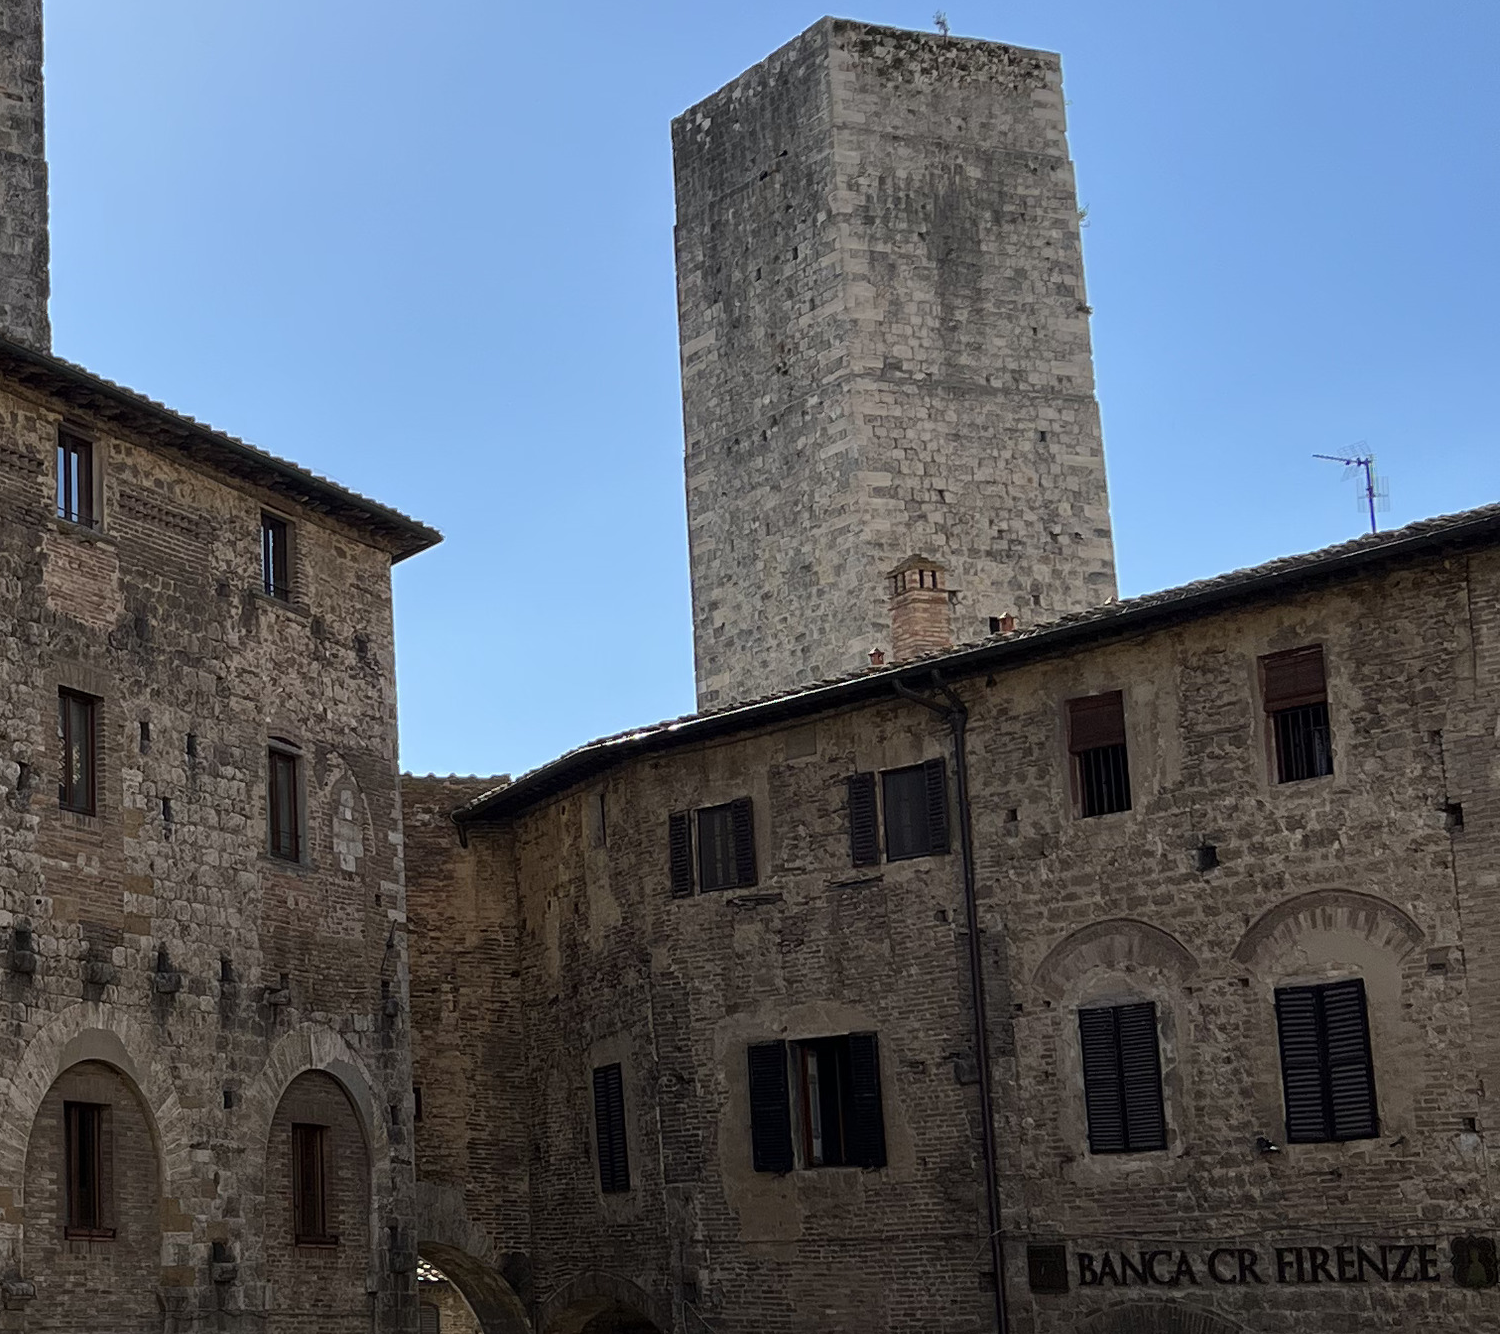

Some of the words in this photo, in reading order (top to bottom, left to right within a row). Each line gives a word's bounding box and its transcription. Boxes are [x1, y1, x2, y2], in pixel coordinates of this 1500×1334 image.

[1077, 1250, 1200, 1287] BANCA
[1207, 1248, 1268, 1285] CR
[1274, 1244, 1441, 1284] FIRENZE
